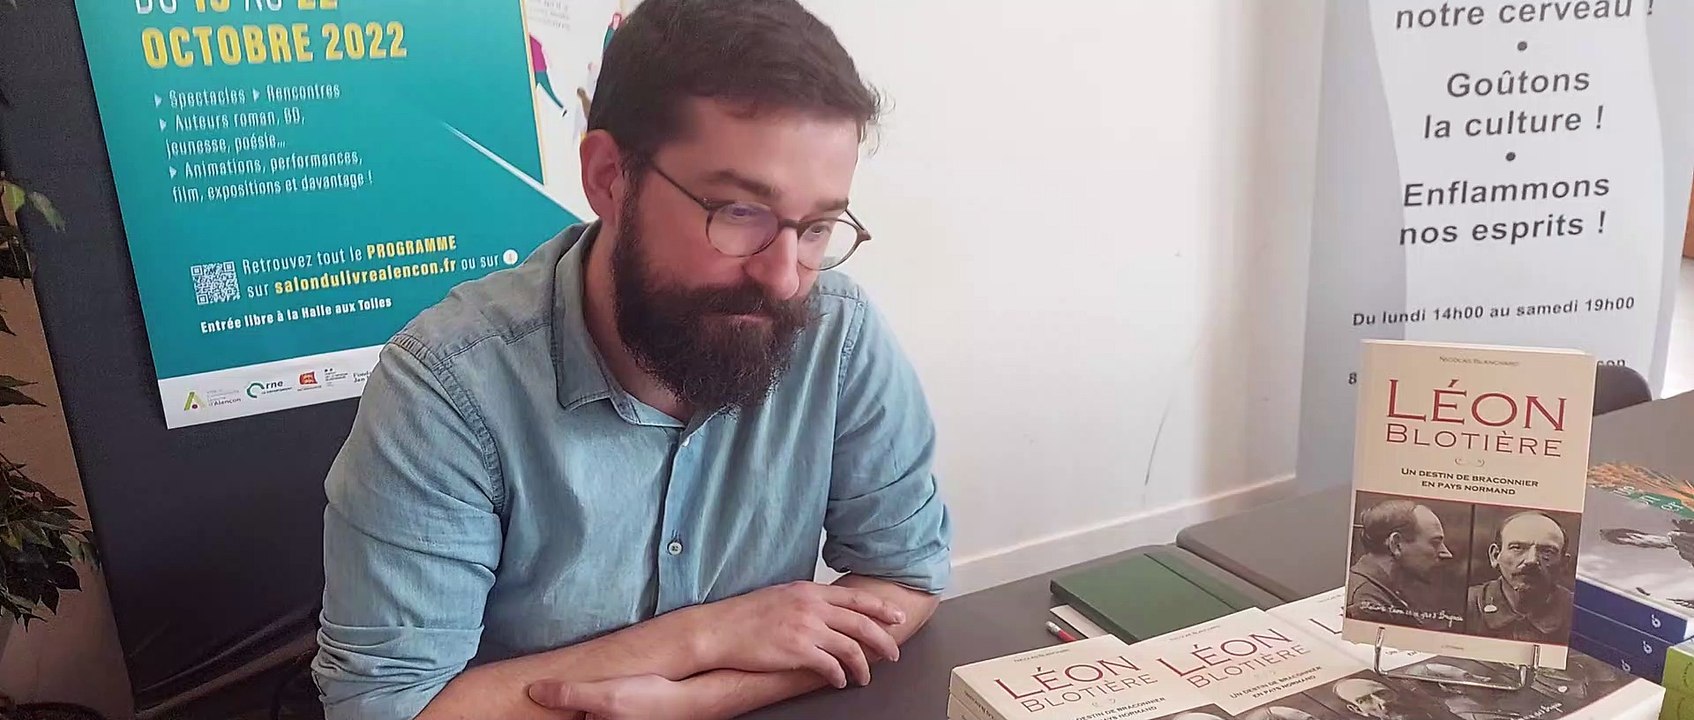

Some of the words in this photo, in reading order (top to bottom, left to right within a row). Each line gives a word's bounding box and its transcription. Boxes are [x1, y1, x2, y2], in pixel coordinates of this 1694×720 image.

[1396, 2, 1484, 30] notre
[1499, 0, 1632, 23] cerveau
[142, 23, 313, 69] OCTOBRE
[322, 21, 407, 60] 2022
[169, 86, 246, 109] Spectacles
[267, 83, 340, 102] Rencontres
[1447, 70, 1590, 98] Goûtons
[175, 113, 229, 132] Auteurs
[234, 110, 280, 127] roman,
[283, 106, 305, 125] BD,
[1424, 114, 1451, 139] la
[1465, 110, 1582, 136] culture
[1595, 105, 1604, 129] !
[166, 138, 231, 160] jeunesse,
[185, 158, 266, 179] Animations,
[271, 151, 362, 173] performances,
[172, 185, 204, 203] film,
[207, 180, 281, 202] expositions
[285, 177, 297, 192] et
[301, 172, 364, 191] davantage
[1403, 177, 1610, 207] Enflammons
[1400, 221, 1458, 245] nos
[1472, 214, 1584, 245] esprits
[1598, 211, 1606, 234] !
[242, 254, 312, 275] Retrouvez
[317, 248, 346, 264] tout
[350, 246, 362, 262] le
[366, 235, 457, 260] PROGRAMME
[247, 283, 269, 298] sur
[274, 257, 456, 294] salondulivrealencon.fr
[461, 257, 476, 270] ou
[480, 253, 500, 268] sur
[200, 318, 242, 334] Entrée
[244, 313, 274, 328] libre
[277, 310, 284, 322] à
[287, 308, 299, 321] la
[302, 304, 332, 319] Halle
[335, 302, 356, 314] aux
[358, 297, 392, 311] Toiles
[1352, 312, 1376, 327] Du
[1382, 309, 1426, 325] lundi
[1433, 305, 1484, 321] 14h00
[1489, 306, 1511, 318] au
[1516, 300, 1578, 316] samedi
[1584, 296, 1635, 311] 19h00
[1348, 372, 1358, 385] 8
[1386, 379, 1567, 431] LÉON
[1386, 423, 1563, 457] BLOTIÈRE
[1401, 467, 1417, 476] UN
[1419, 470, 1454, 479] DESTIN
[1456, 473, 1470, 481] DE
[1472, 475, 1539, 487] BRACONNIER
[1421, 480, 1435, 488] EN
[1437, 482, 1462, 490] PAYS
[1464, 484, 1516, 495] NORMAND
[1156, 628, 1293, 677] LÉON
[1187, 644, 1311, 689] BLOTIÈRE
[994, 656, 1141, 700] LÉON
[1021, 673, 1159, 713] BLOTIÈRE
